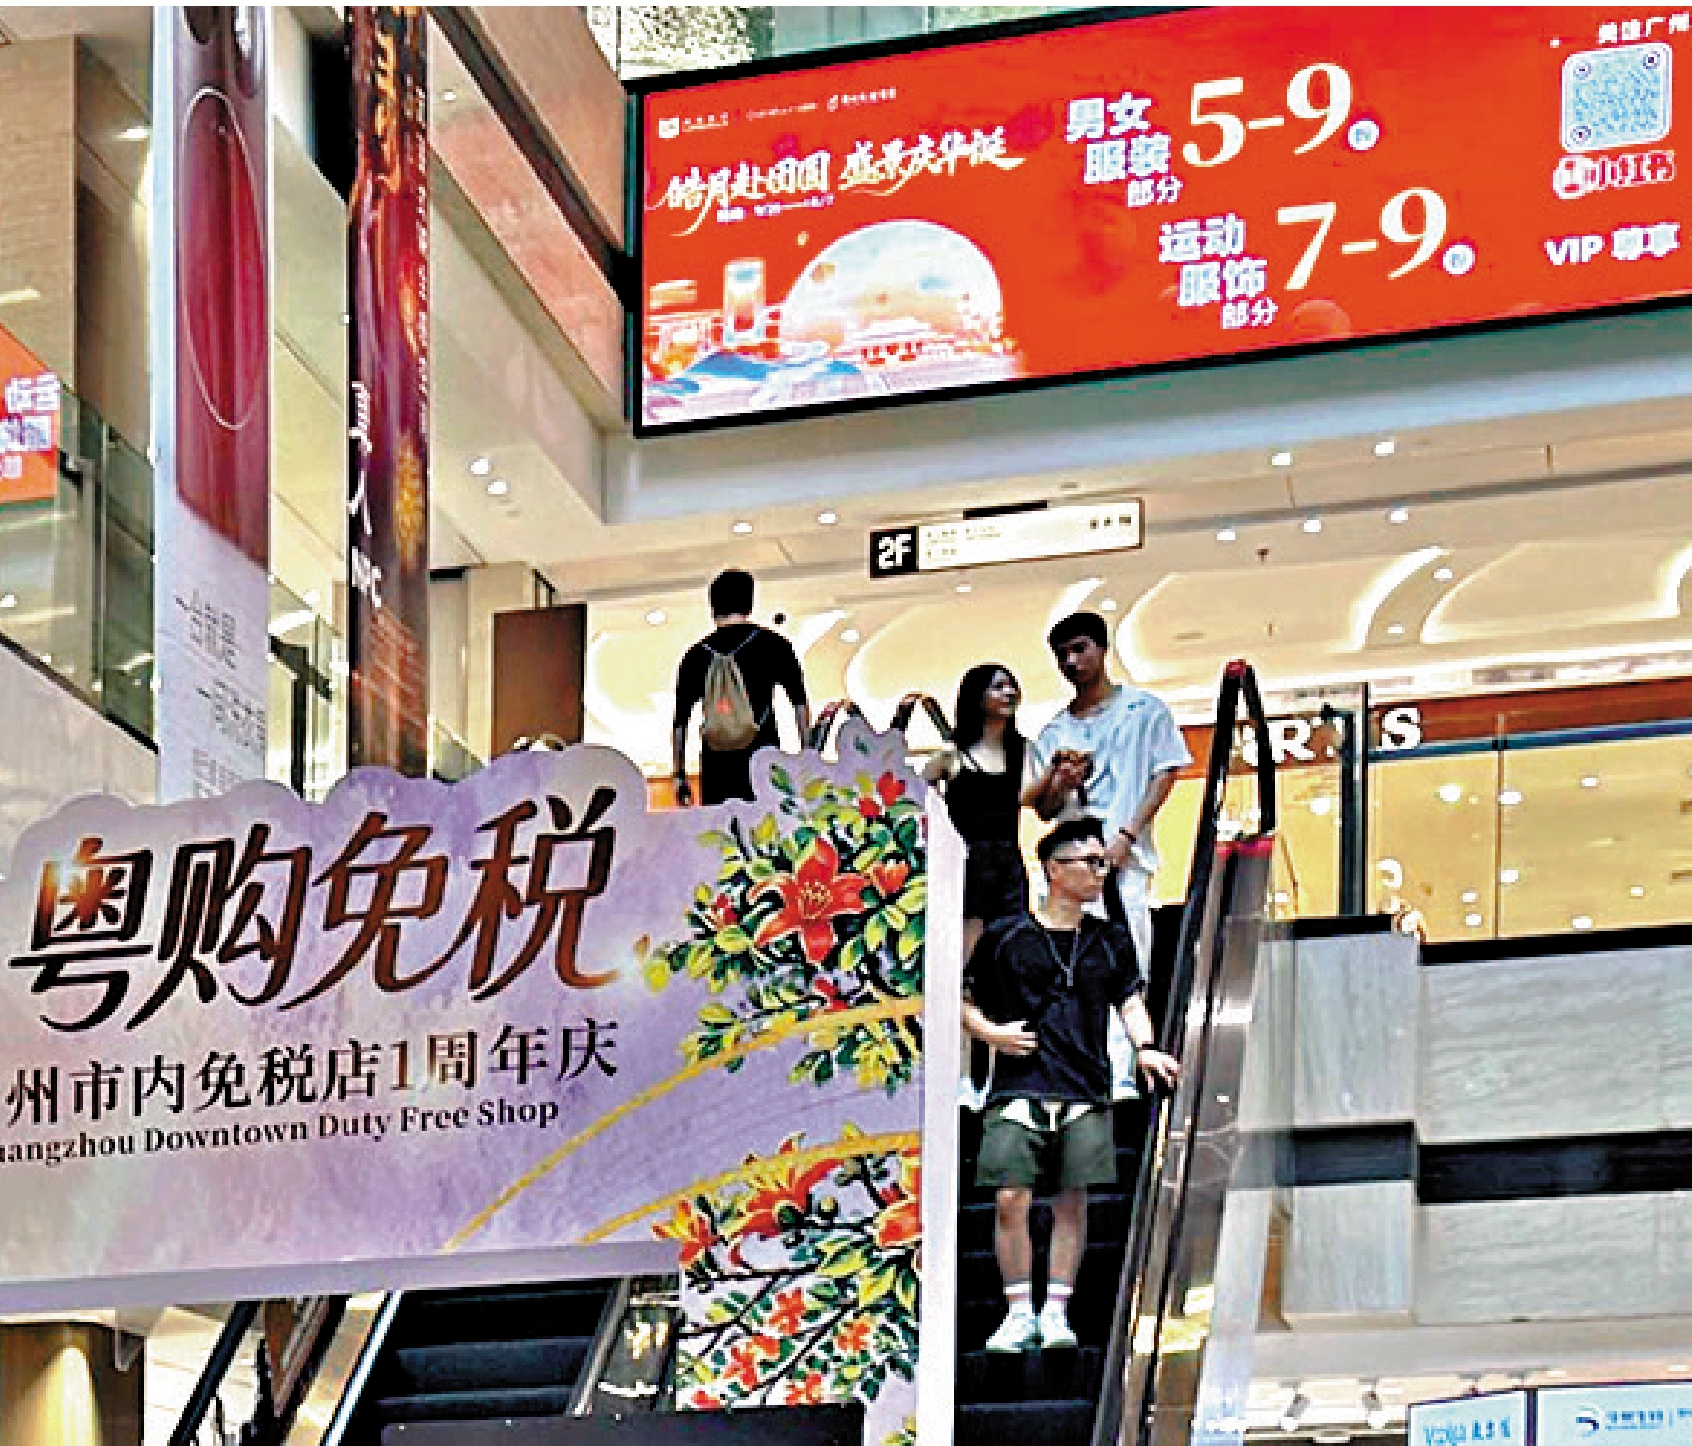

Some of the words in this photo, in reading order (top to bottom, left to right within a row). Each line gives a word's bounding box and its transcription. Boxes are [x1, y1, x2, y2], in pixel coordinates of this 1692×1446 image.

[1065, 92, 1152, 144] 男女
[1182, 63, 1353, 168] 5-9
[1158, 212, 1247, 263] 运动
[1276, 186, 1448, 291] 7-9
[1544, 234, 1606, 266] VIP
[878, 533, 912, 570] 2F
[145, 1121, 308, 1153] Downtown
[319, 1112, 391, 1142] Duty
[400, 1106, 470, 1132] Free
[477, 1098, 559, 1128] Shop
